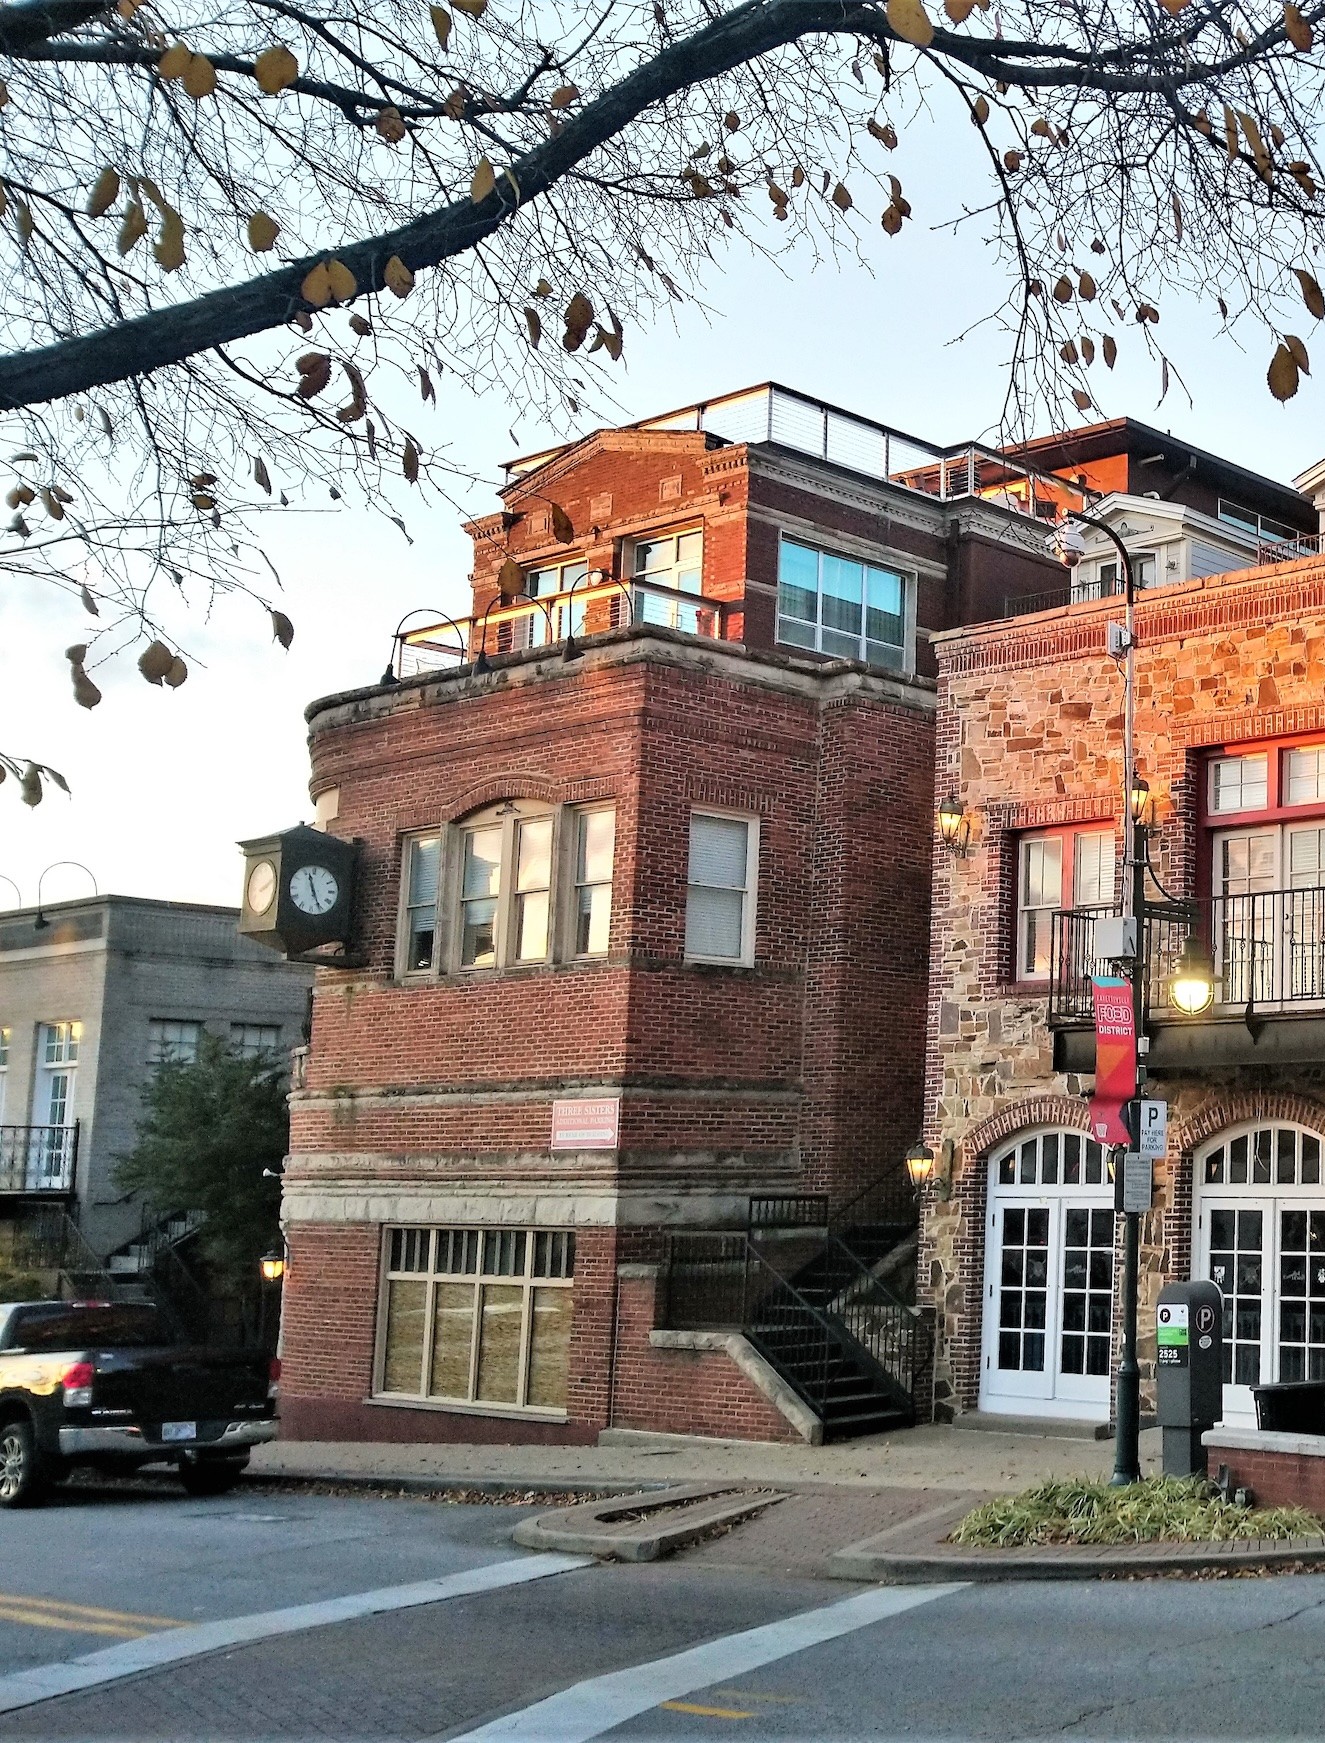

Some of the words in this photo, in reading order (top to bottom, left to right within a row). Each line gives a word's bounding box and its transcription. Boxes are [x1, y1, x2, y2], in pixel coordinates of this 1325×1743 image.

[1097, 1004, 1132, 1024] FOOD
[1099, 1025, 1132, 1035] DISTRICT
[556, 1106, 583, 1116] THREE
[584, 1104, 615, 1115] SISTERS
[1149, 1107, 1158, 1127] P
[1201, 1309, 1211, 1329] P
[1159, 1350, 1178, 1358] 2525
